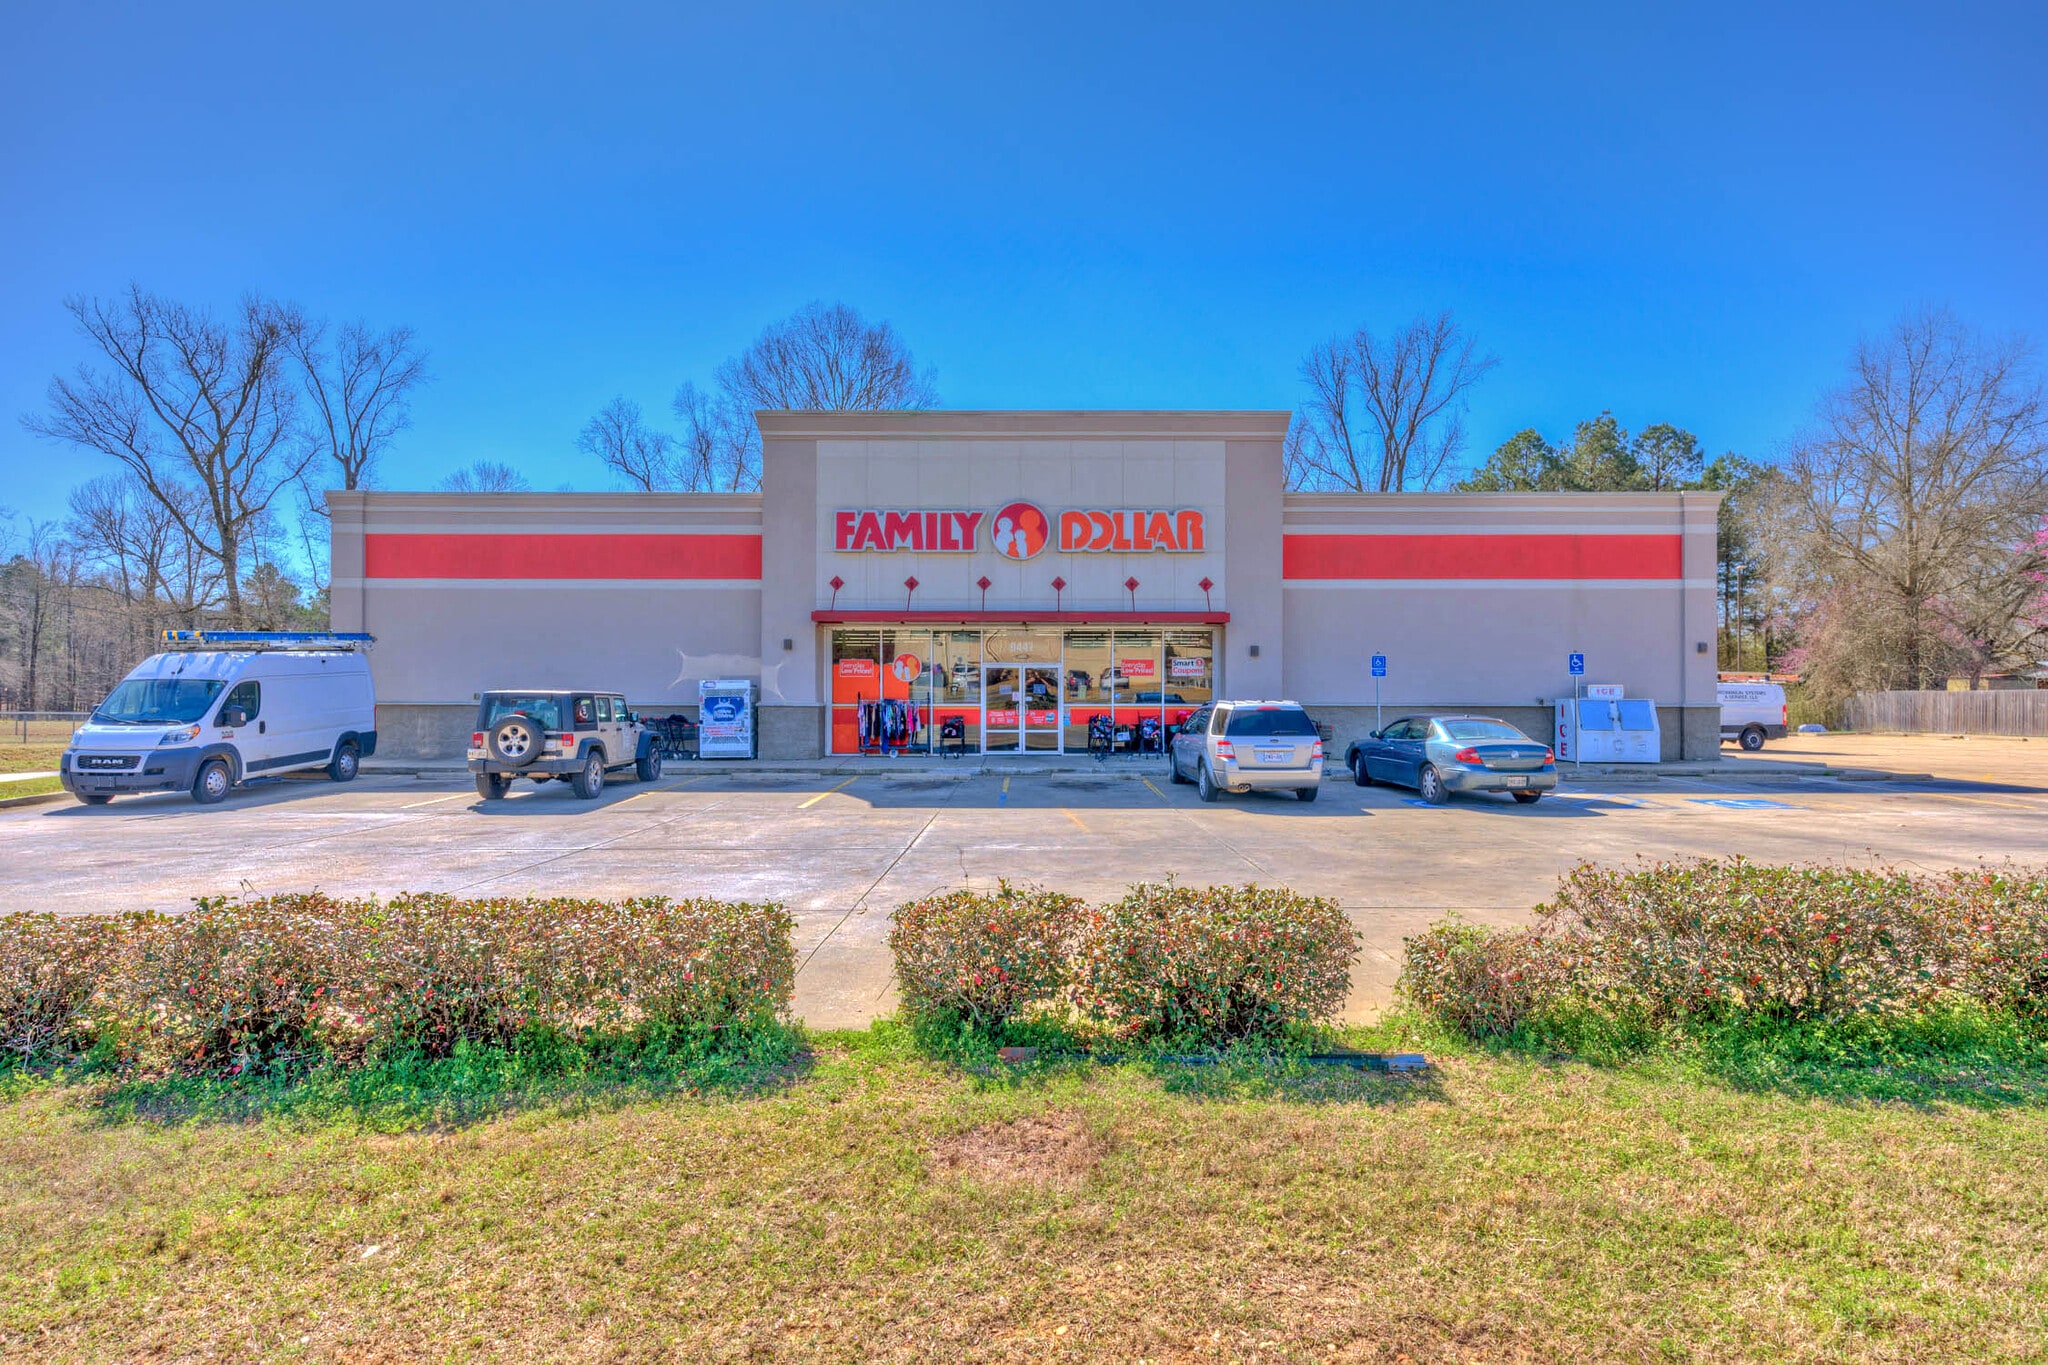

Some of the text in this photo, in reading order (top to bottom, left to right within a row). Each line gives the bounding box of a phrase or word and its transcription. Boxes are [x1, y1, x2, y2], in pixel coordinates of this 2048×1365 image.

[834, 510, 1204, 551] FAMILY DOLLAR
[1172, 667, 1204, 675] Coupons
[1559, 703, 1568, 757] ICE
